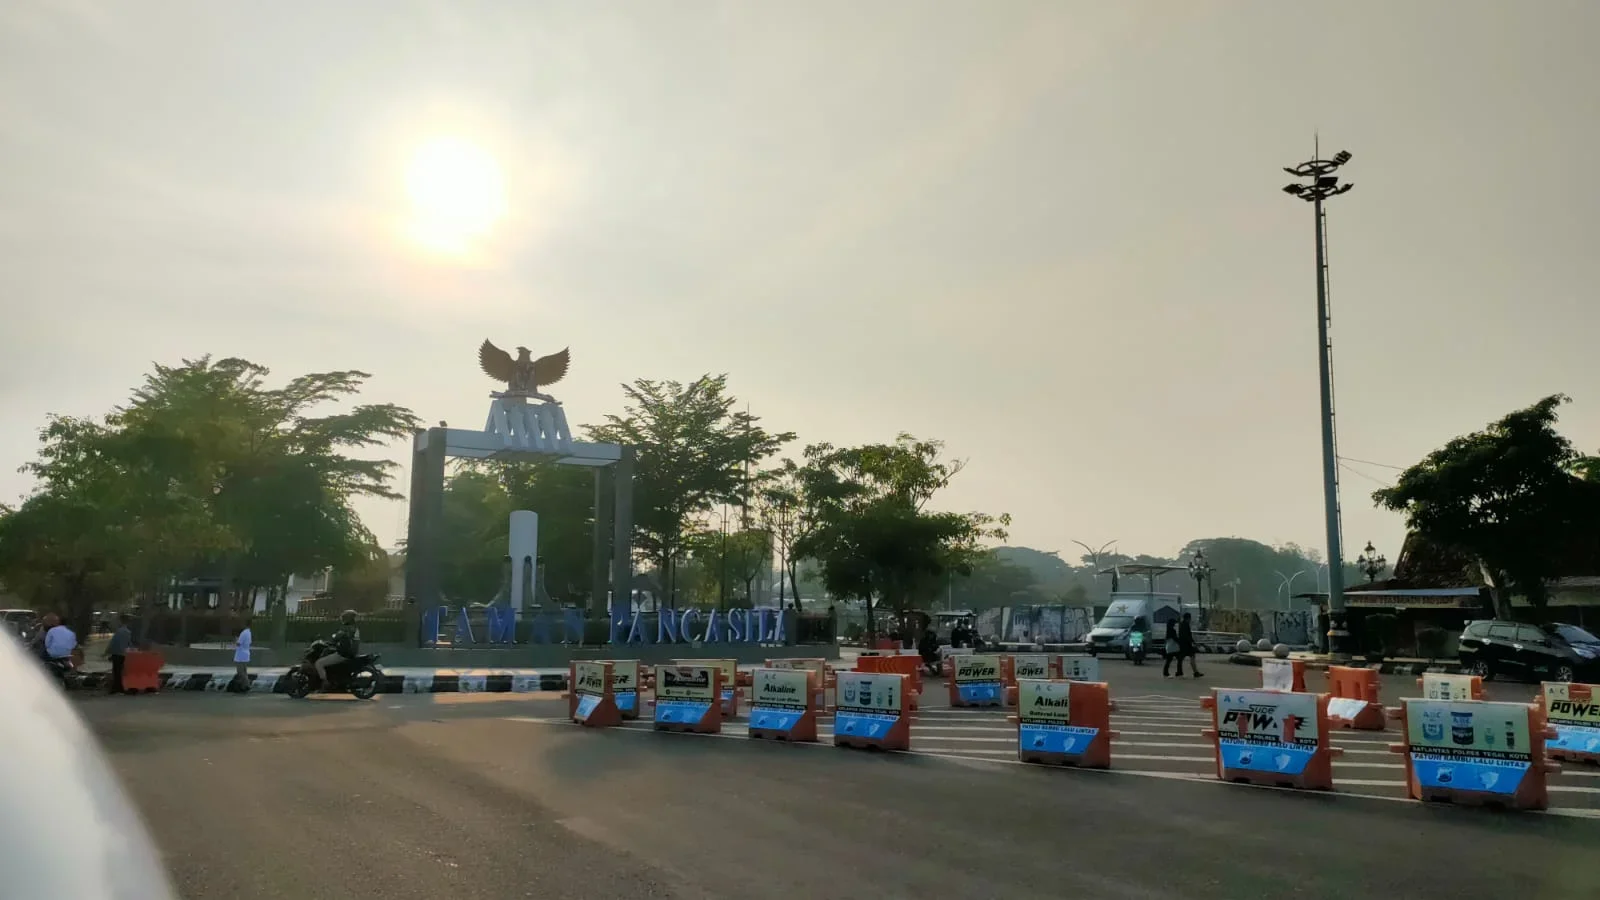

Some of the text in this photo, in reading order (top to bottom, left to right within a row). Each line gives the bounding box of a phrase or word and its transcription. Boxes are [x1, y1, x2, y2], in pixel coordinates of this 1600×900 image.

[422, 604, 788, 645] TAMAN PANCASILA
[958, 666, 996, 677] POWER
[763, 683, 797, 694] Alkaline
[1034, 696, 1068, 708] Alkali
[1550, 701, 1600, 718] POWE
[1412, 746, 1450, 754] SATLANTAS
[1452, 749, 1480, 757] POLRES
[1414, 753, 1441, 761] PATUHI
[1496, 760, 1525, 768] LINTAS
